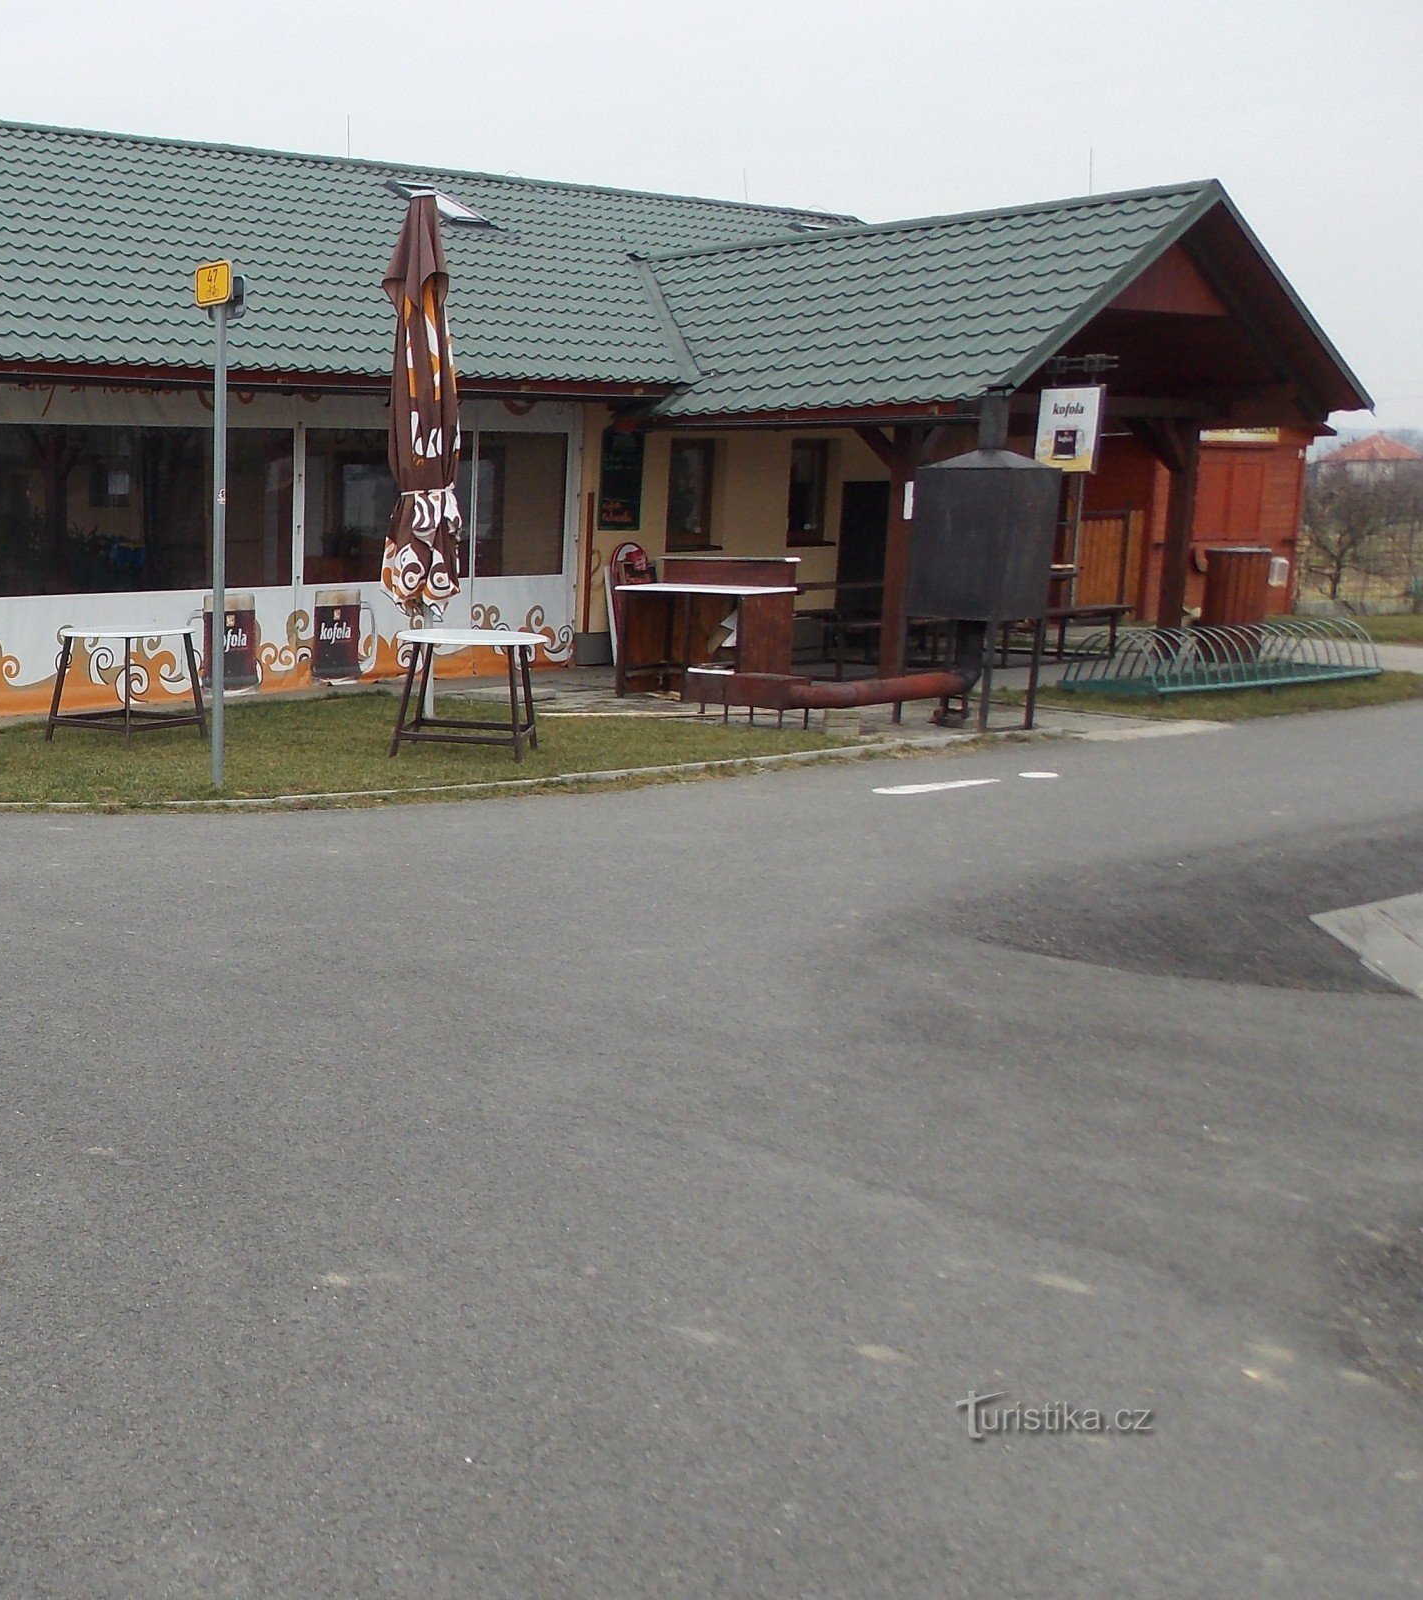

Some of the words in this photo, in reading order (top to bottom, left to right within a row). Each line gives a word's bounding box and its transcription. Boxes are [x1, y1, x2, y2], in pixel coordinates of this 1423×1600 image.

[207, 268, 218, 284] 47
[1052, 402, 1085, 418] kofola
[223, 628, 247, 652] ofola
[319, 622, 351, 644] kofola
